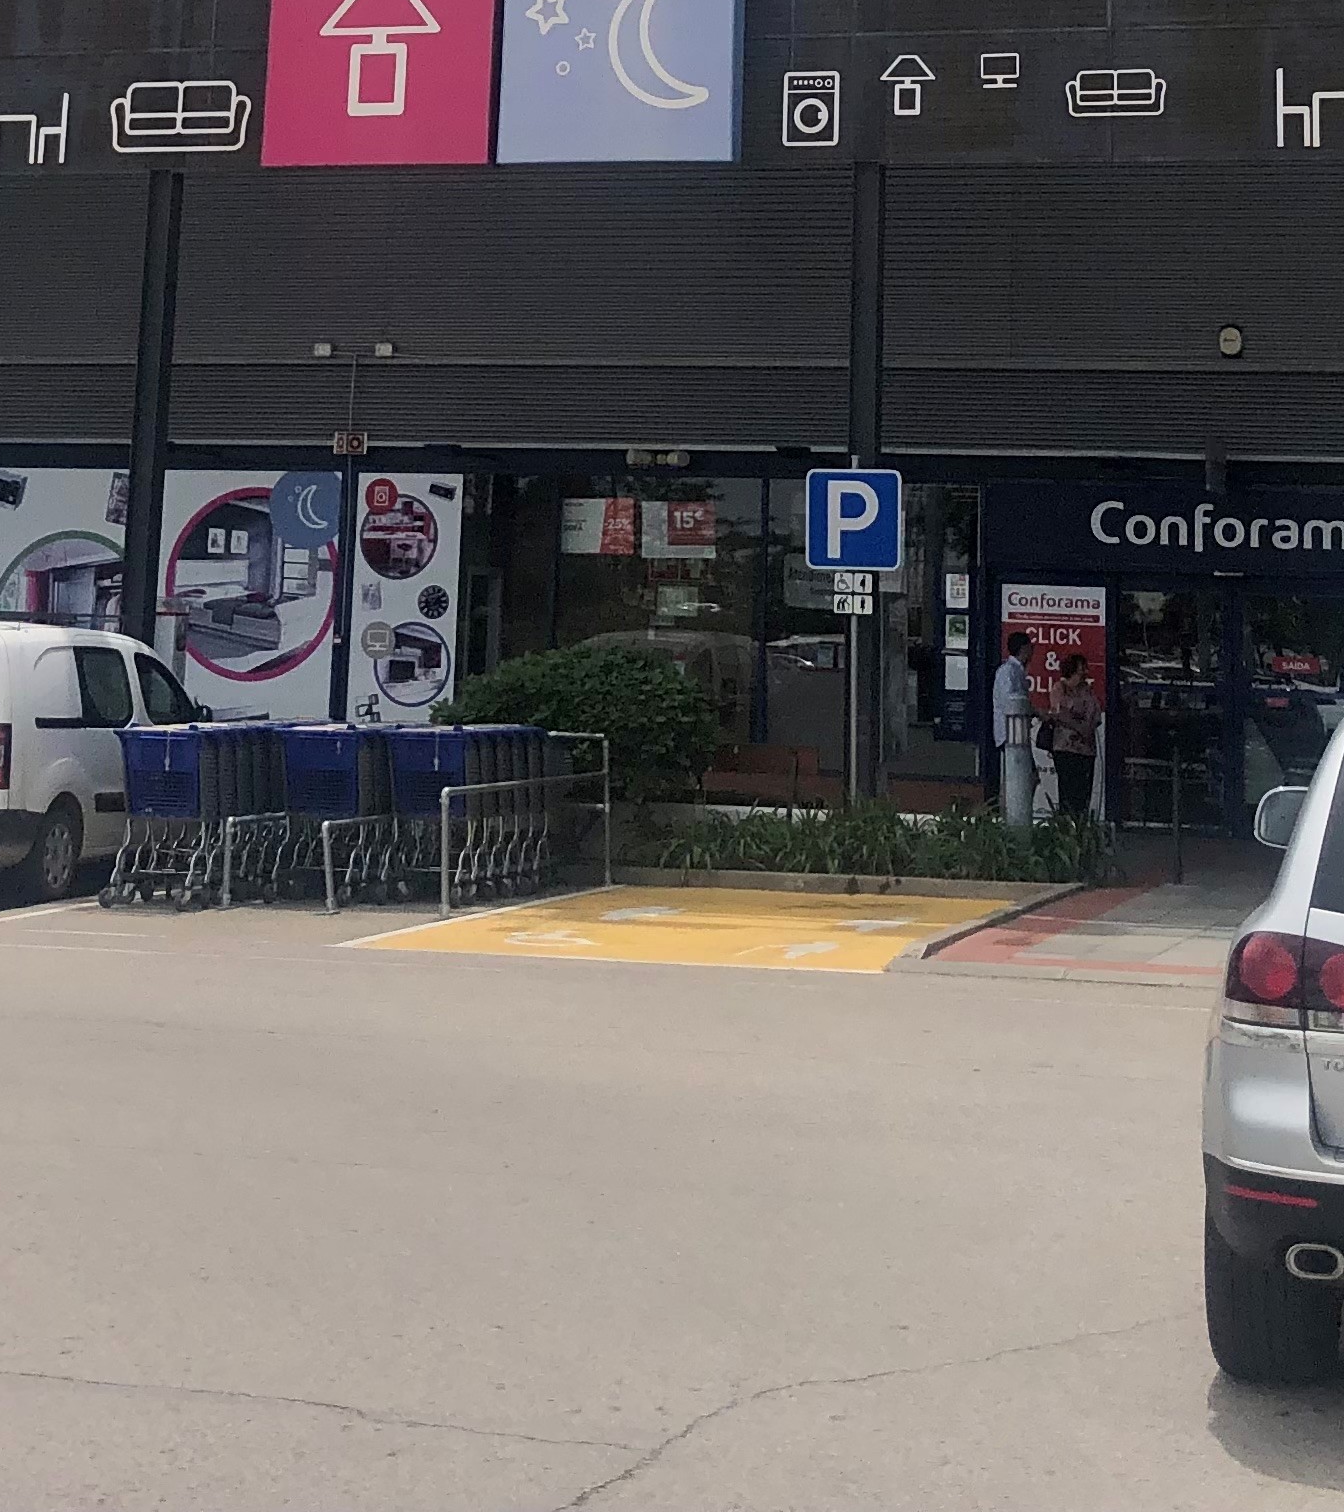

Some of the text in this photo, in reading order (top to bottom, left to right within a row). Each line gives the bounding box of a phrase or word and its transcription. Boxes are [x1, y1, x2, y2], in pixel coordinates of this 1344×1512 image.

[827, 479, 879, 559] P
[1007, 591, 1101, 609] Conforama
[1045, 651, 1061, 671] &
